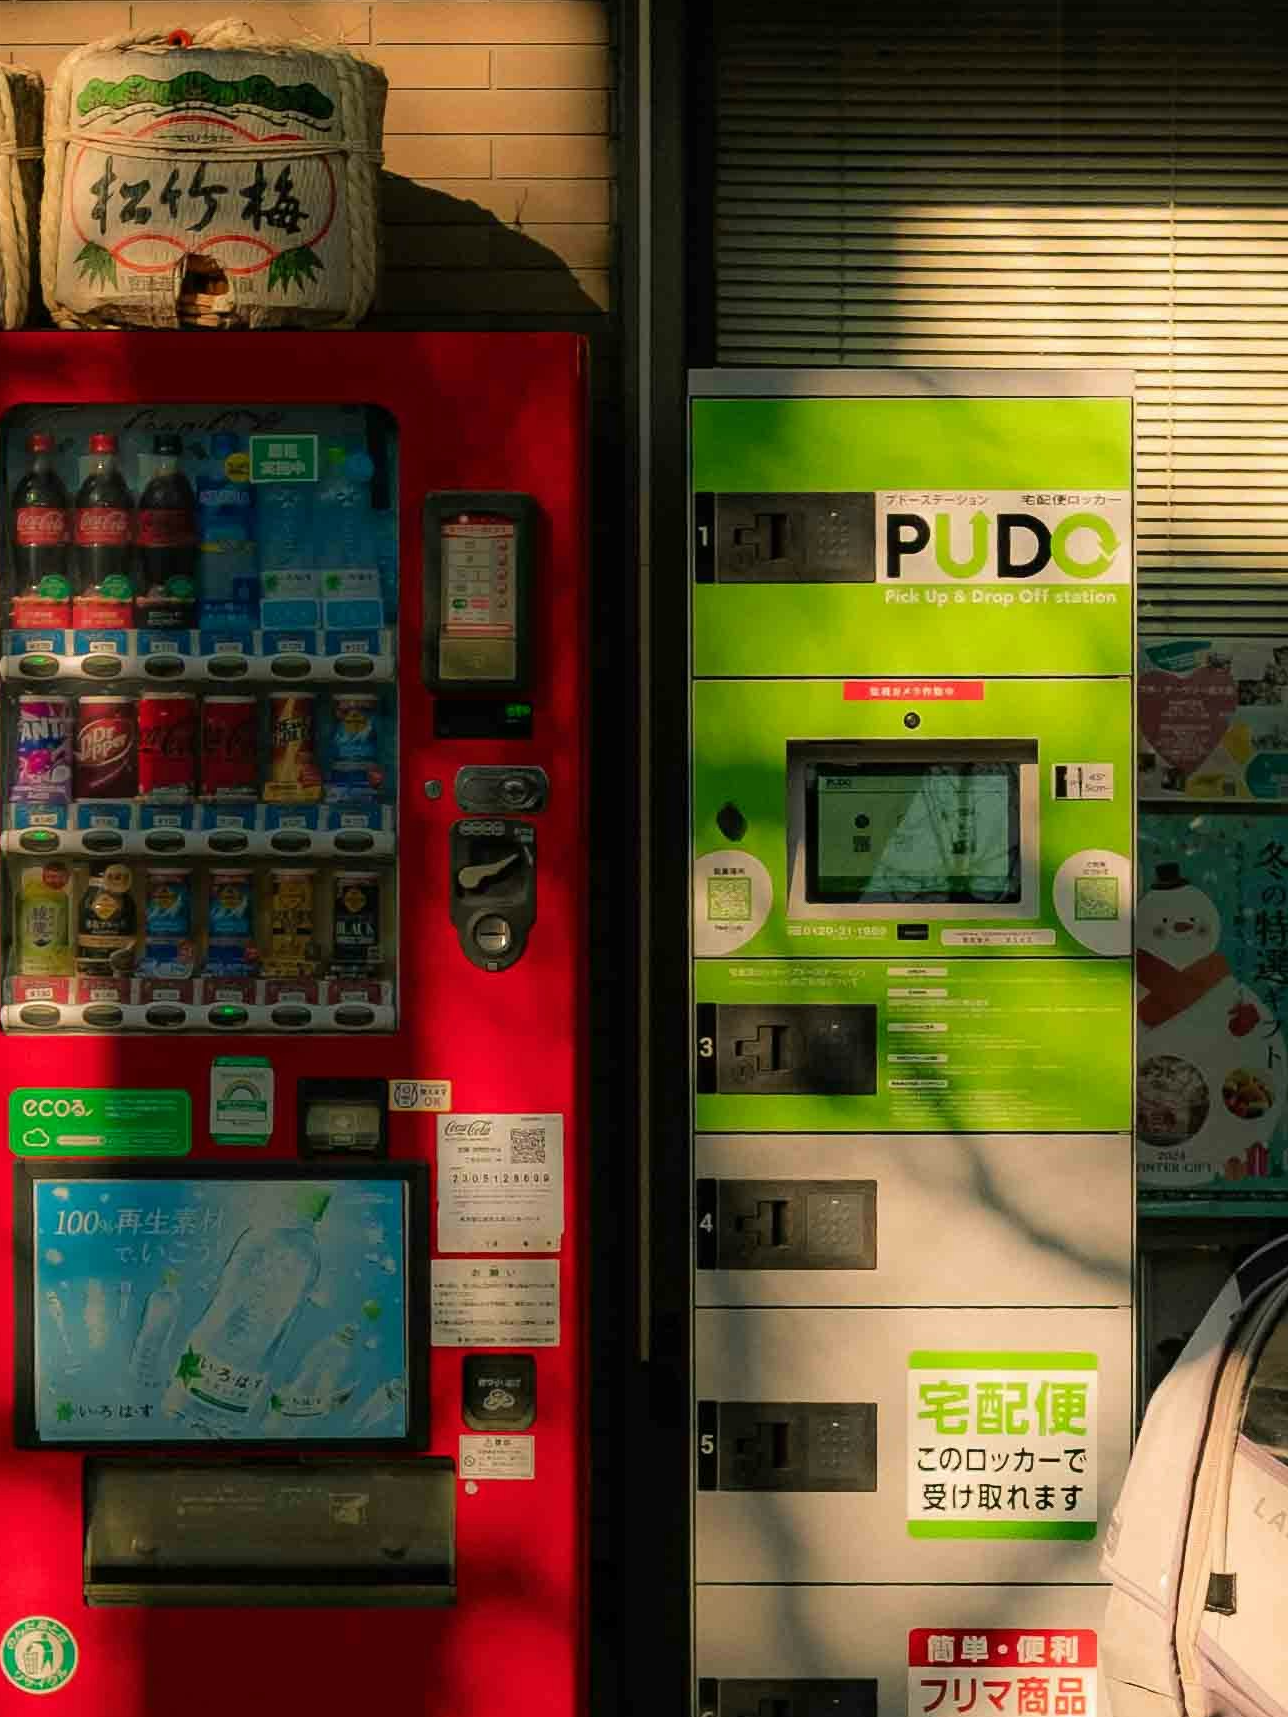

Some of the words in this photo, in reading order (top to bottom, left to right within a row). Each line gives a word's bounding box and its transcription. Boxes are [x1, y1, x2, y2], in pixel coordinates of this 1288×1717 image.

[90, 156, 310, 236] 松竹梅
[1022, 494, 1122, 506] 宅配便ロッカー
[697, 527, 708, 547] 1
[886, 510, 1121, 578] PUDO
[885, 589, 919, 604] Pick
[926, 589, 949, 607] Up
[954, 590, 966, 603] &
[972, 589, 1013, 607] Drop
[1019, 589, 1049, 603] Off
[1056, 590, 1117, 604] station
[699, 1037, 713, 1058] 3
[444, 1120, 493, 1136] Coca-Cola
[1137, 1162, 1181, 1173] INTER
[698, 1213, 713, 1233] 4
[917, 1380, 1089, 1436] 宅配便
[700, 1434, 714, 1454] 5
[917, 1447, 1087, 1473] このロッカーで
[923, 1483, 1083, 1512] 受け取れます
[927, 1635, 1079, 1664] 簡単・便利
[920, 1676, 1086, 1717] フリマ商品
